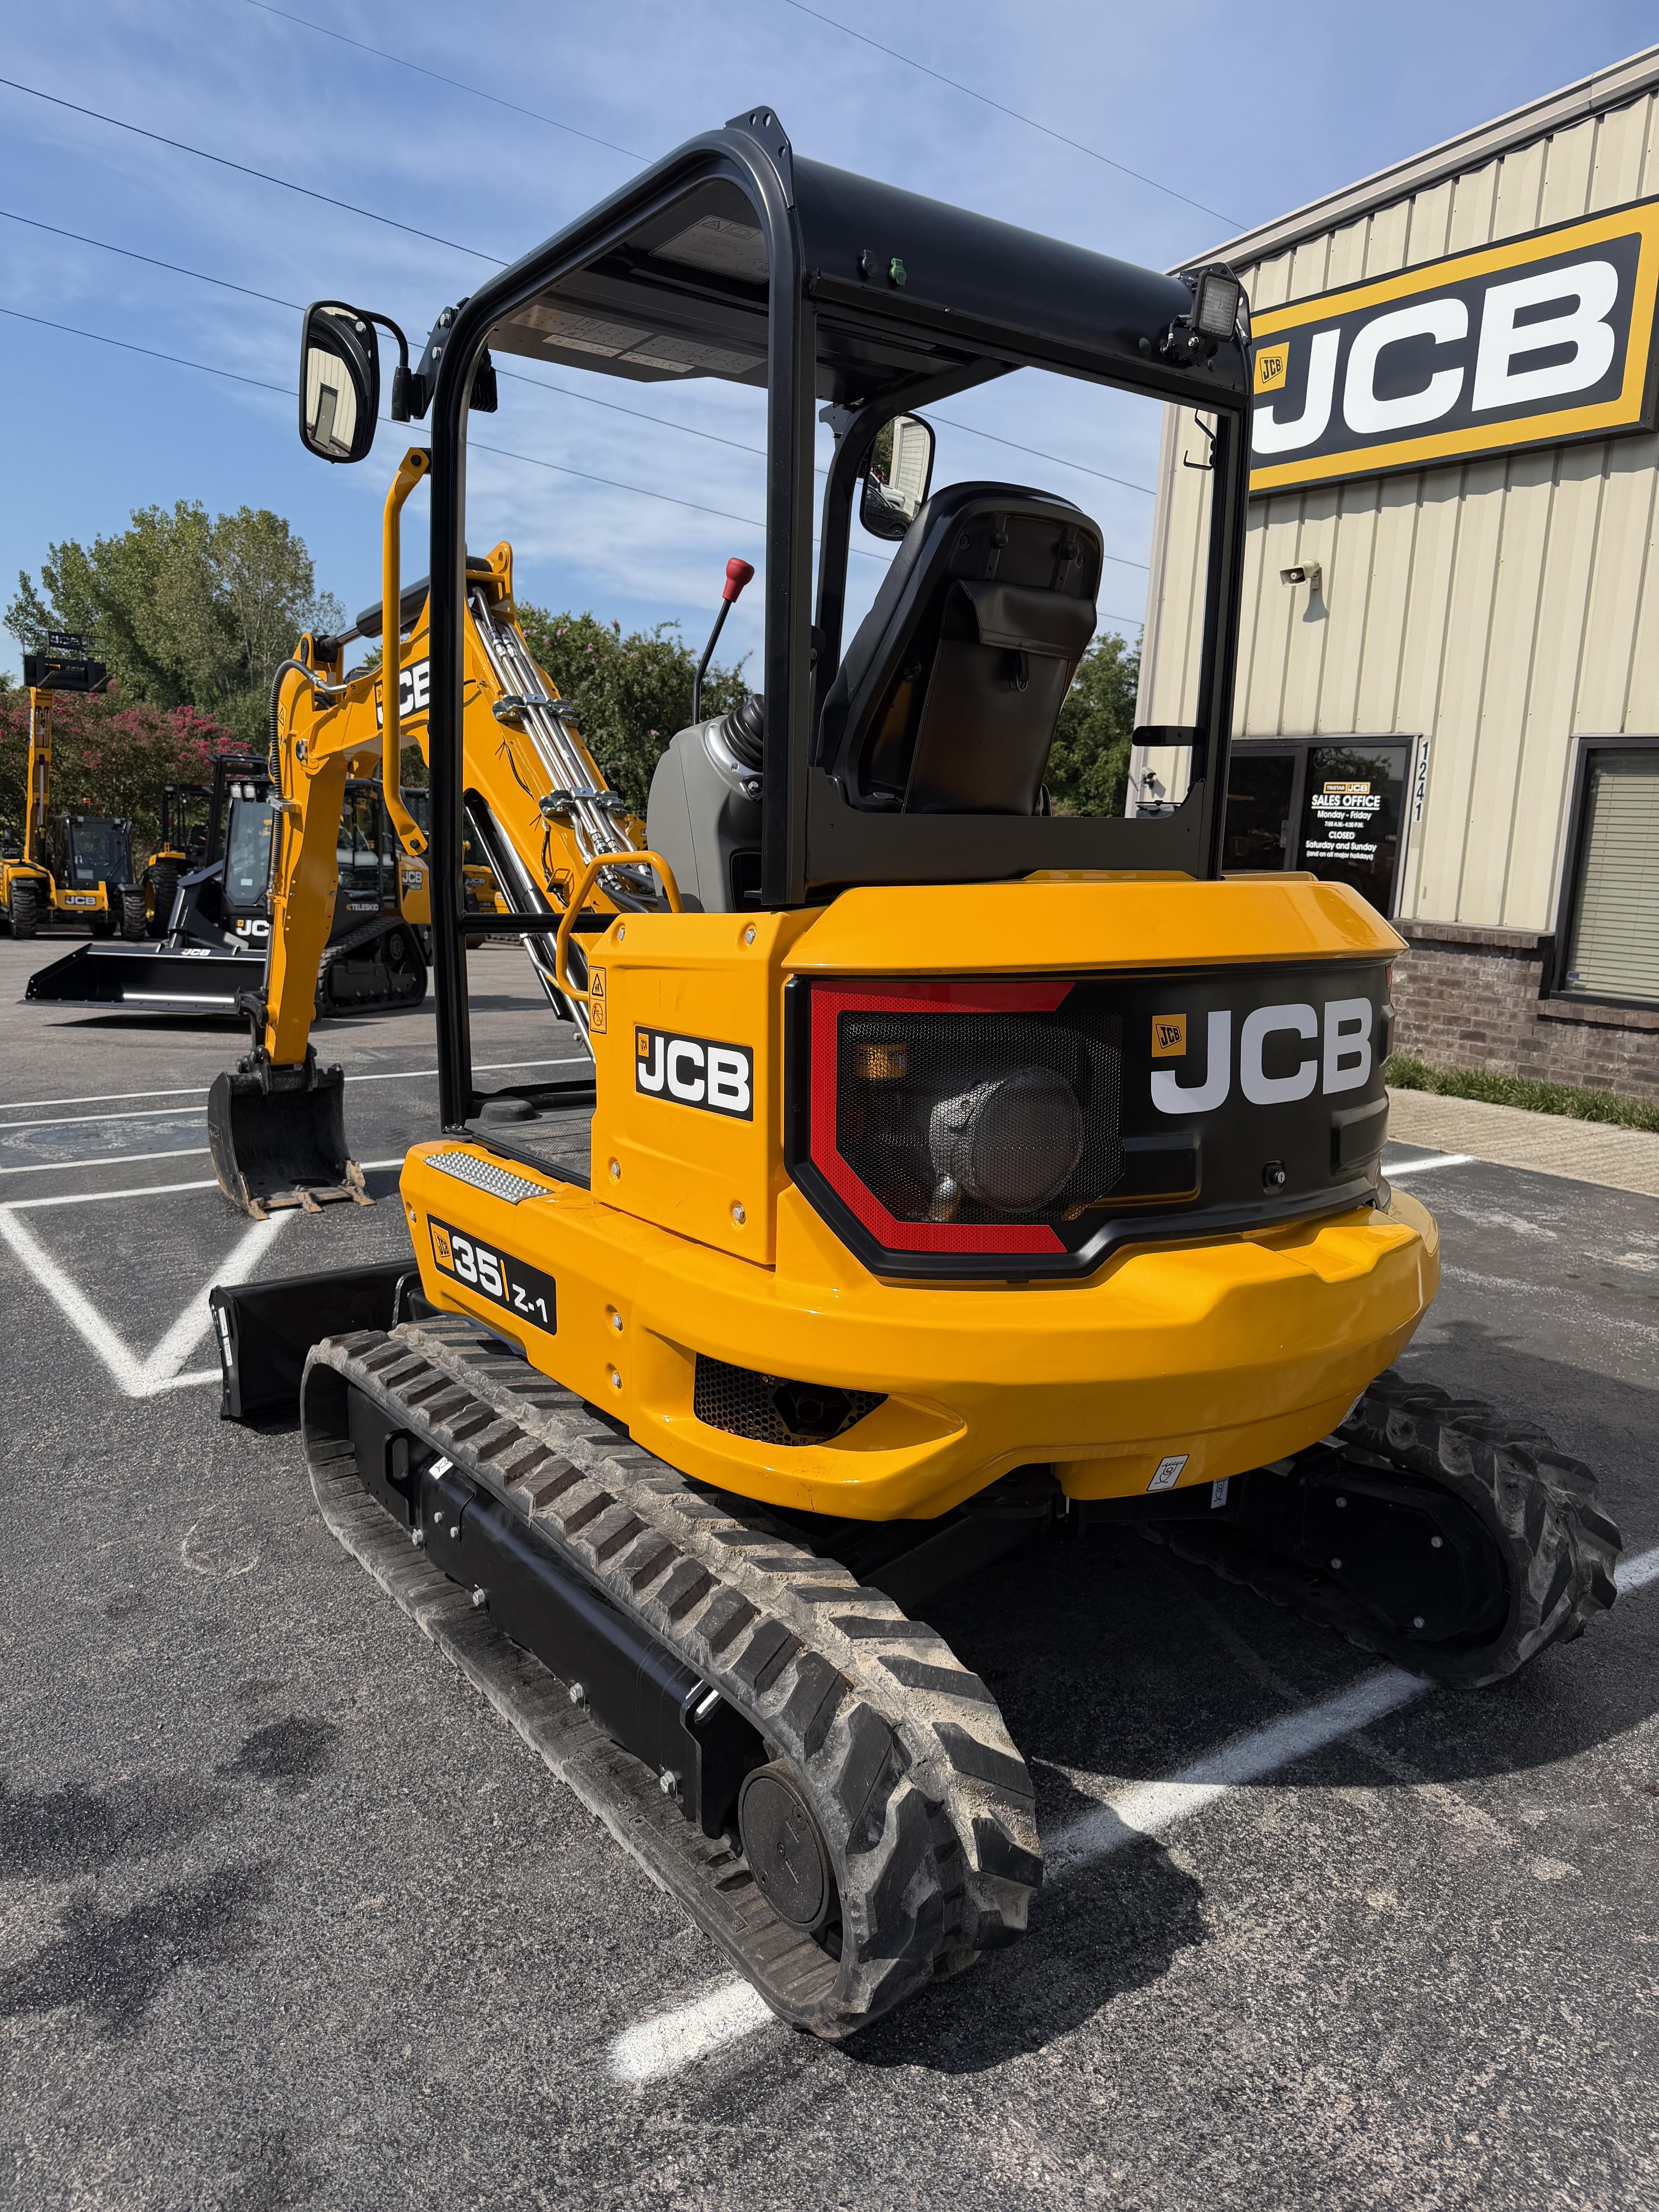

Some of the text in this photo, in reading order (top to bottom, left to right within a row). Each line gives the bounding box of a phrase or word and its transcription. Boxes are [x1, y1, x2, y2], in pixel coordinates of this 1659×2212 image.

[1251, 260, 1619, 454] JCB
[1263, 359, 1281, 380] JCB
[1416, 742, 1429, 821] 1241
[1312, 794, 1381, 807] SALES OFFICE
[1317, 810, 1346, 820] Monday
[1350, 811, 1372, 821] Friday
[1328, 831, 1355, 840] CLOSED
[1305, 840, 1378, 852] Saturday and Sunday
[1350, 852, 1374, 860] holidays)
[403, 871, 422, 883] JCB
[66, 896, 96, 905] JCB
[1160, 1026, 1180, 1046] JCB
[1151, 997, 1372, 1114] JCB
[638, 1036, 750, 1112] JCB
[436, 1235, 449, 1255] JCB
[452, 1236, 548, 1323] 35 Z-1
